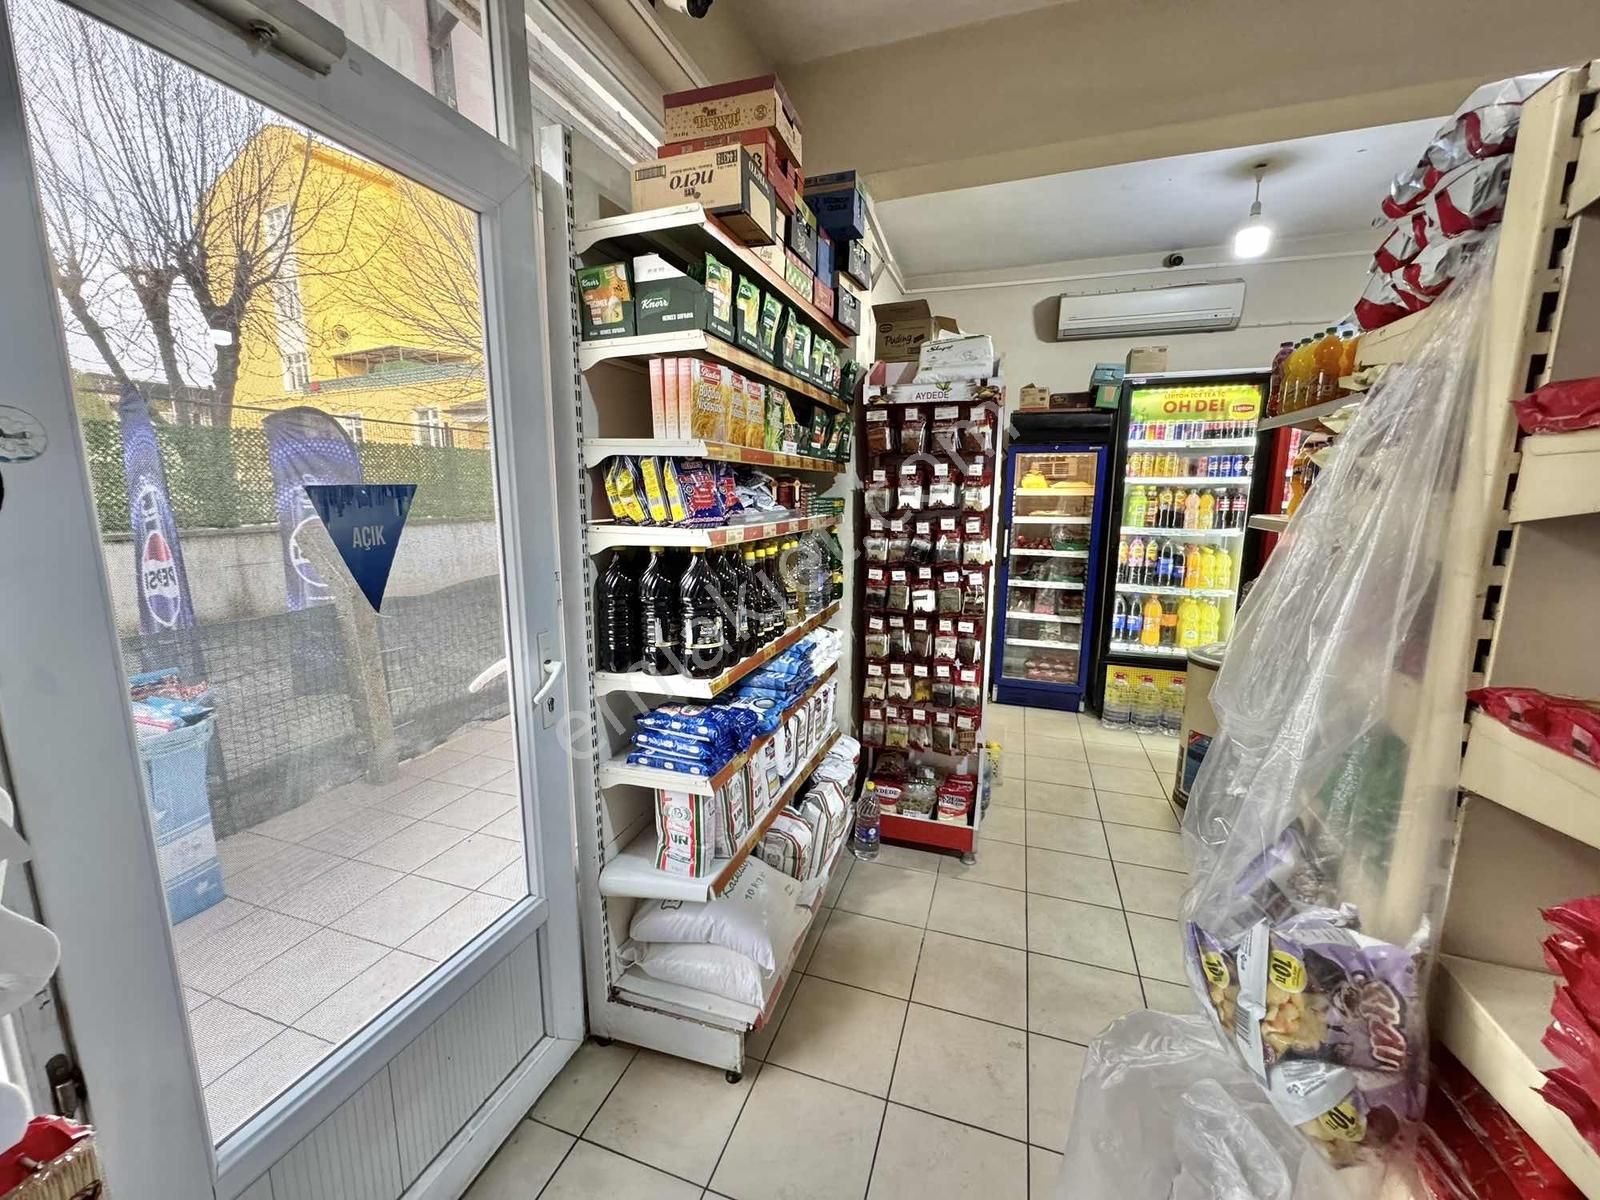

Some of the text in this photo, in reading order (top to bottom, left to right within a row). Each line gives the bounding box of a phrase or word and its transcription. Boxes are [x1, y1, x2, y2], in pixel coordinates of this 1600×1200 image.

[669, 169, 714, 191] nero
[641, 297, 669, 310] Knorr
[915, 391, 950, 401] AYDEDE
[1163, 399, 1226, 414] OH DE!
[352, 525, 387, 550] AÇIK
